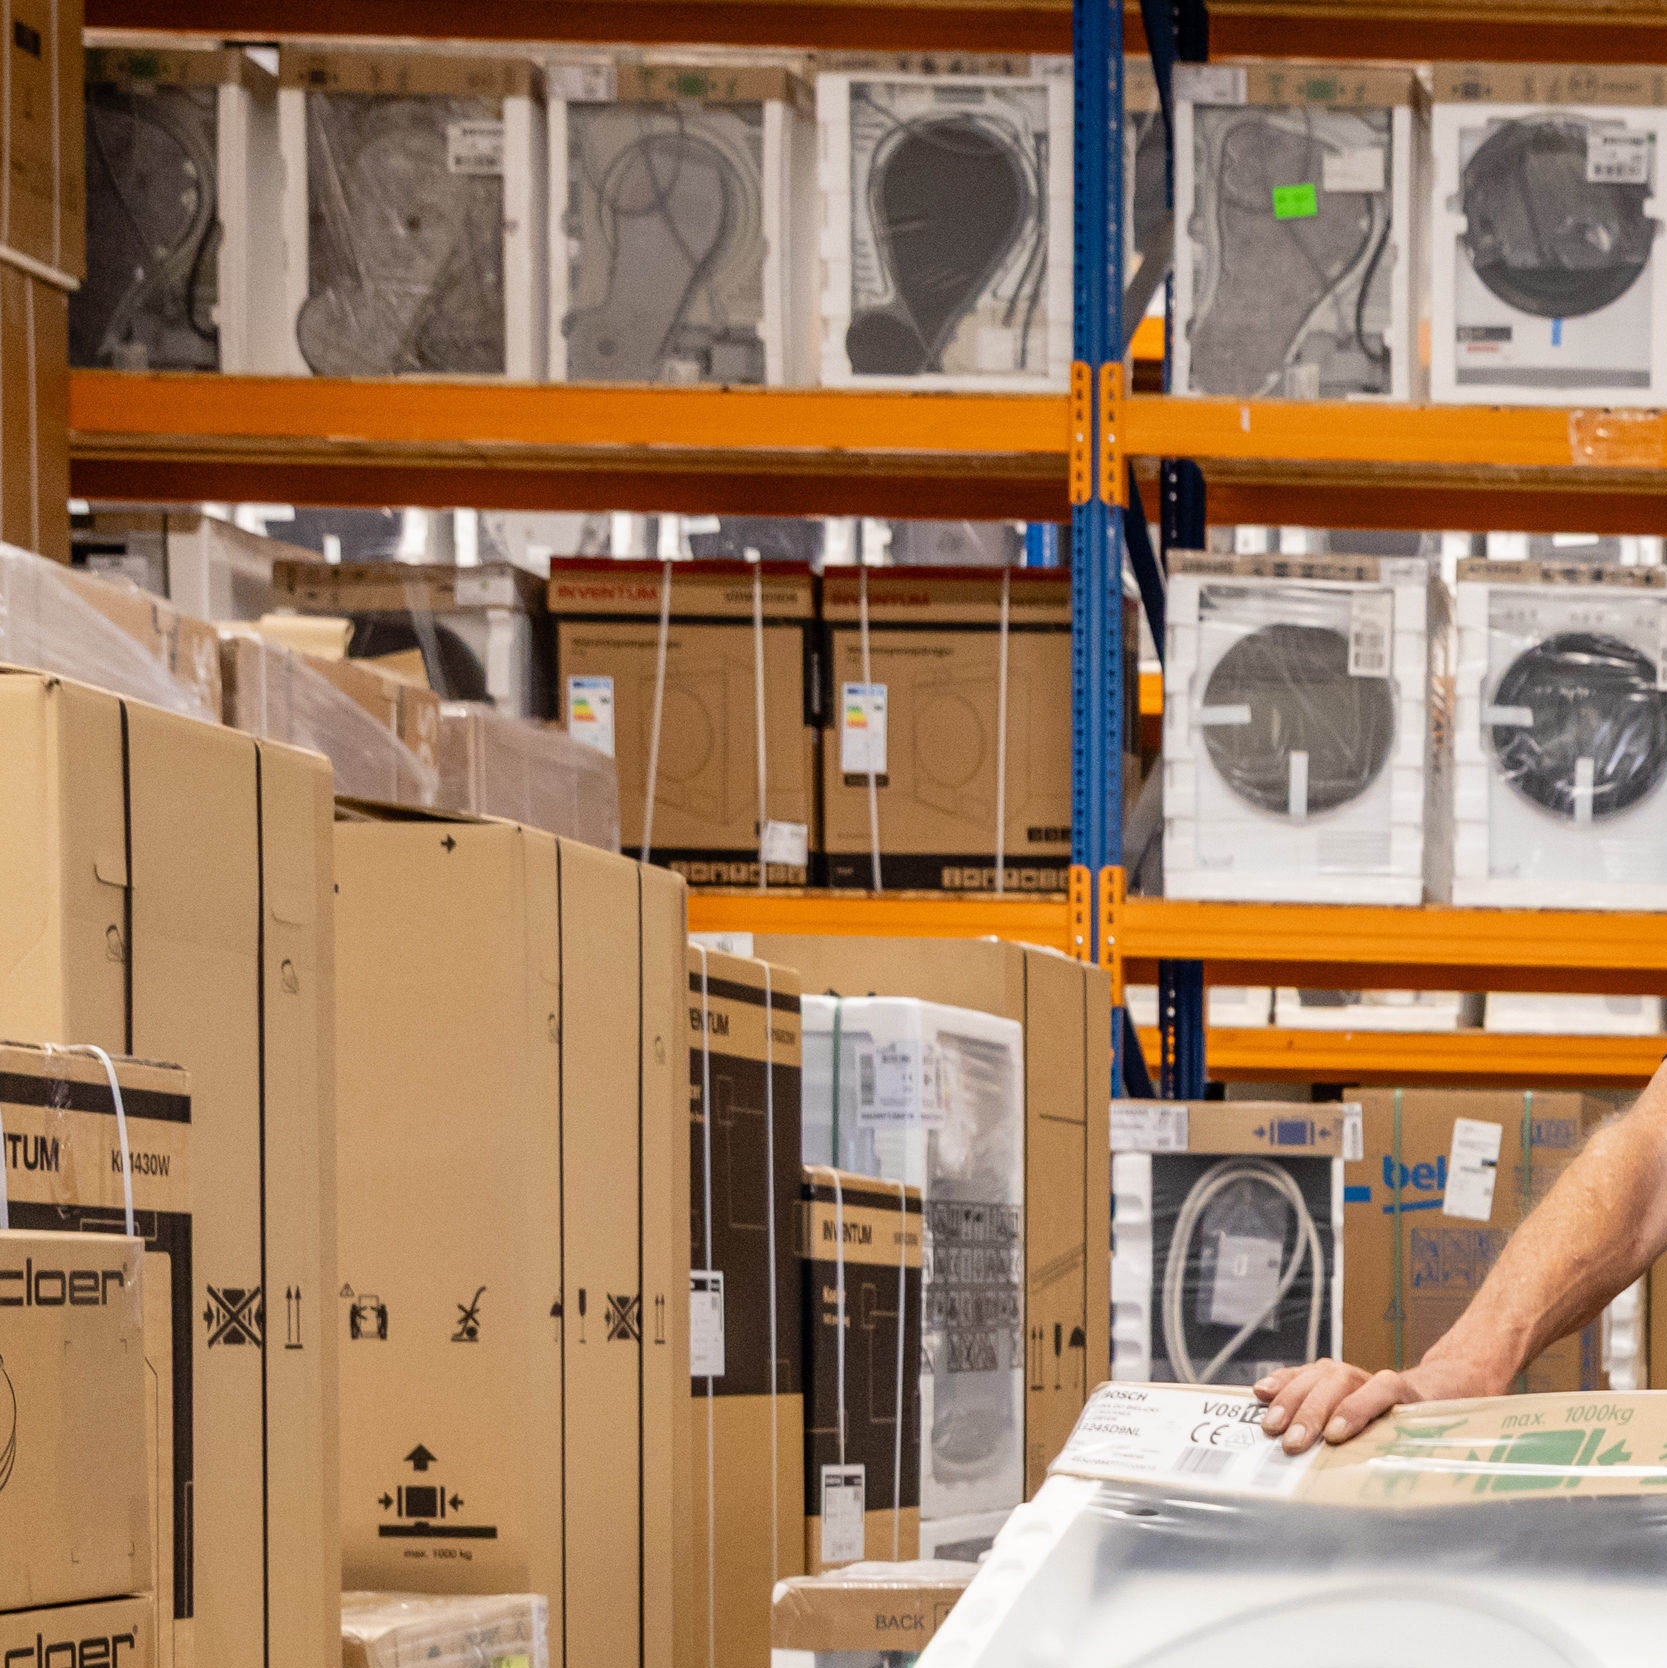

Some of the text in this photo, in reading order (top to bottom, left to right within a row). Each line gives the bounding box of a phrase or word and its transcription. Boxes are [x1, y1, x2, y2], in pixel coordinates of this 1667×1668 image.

[0, 1257, 125, 1306] cloer
[1500, 1403, 1635, 1429] max. 1000kg
[875, 1614, 926, 1631] BACK
